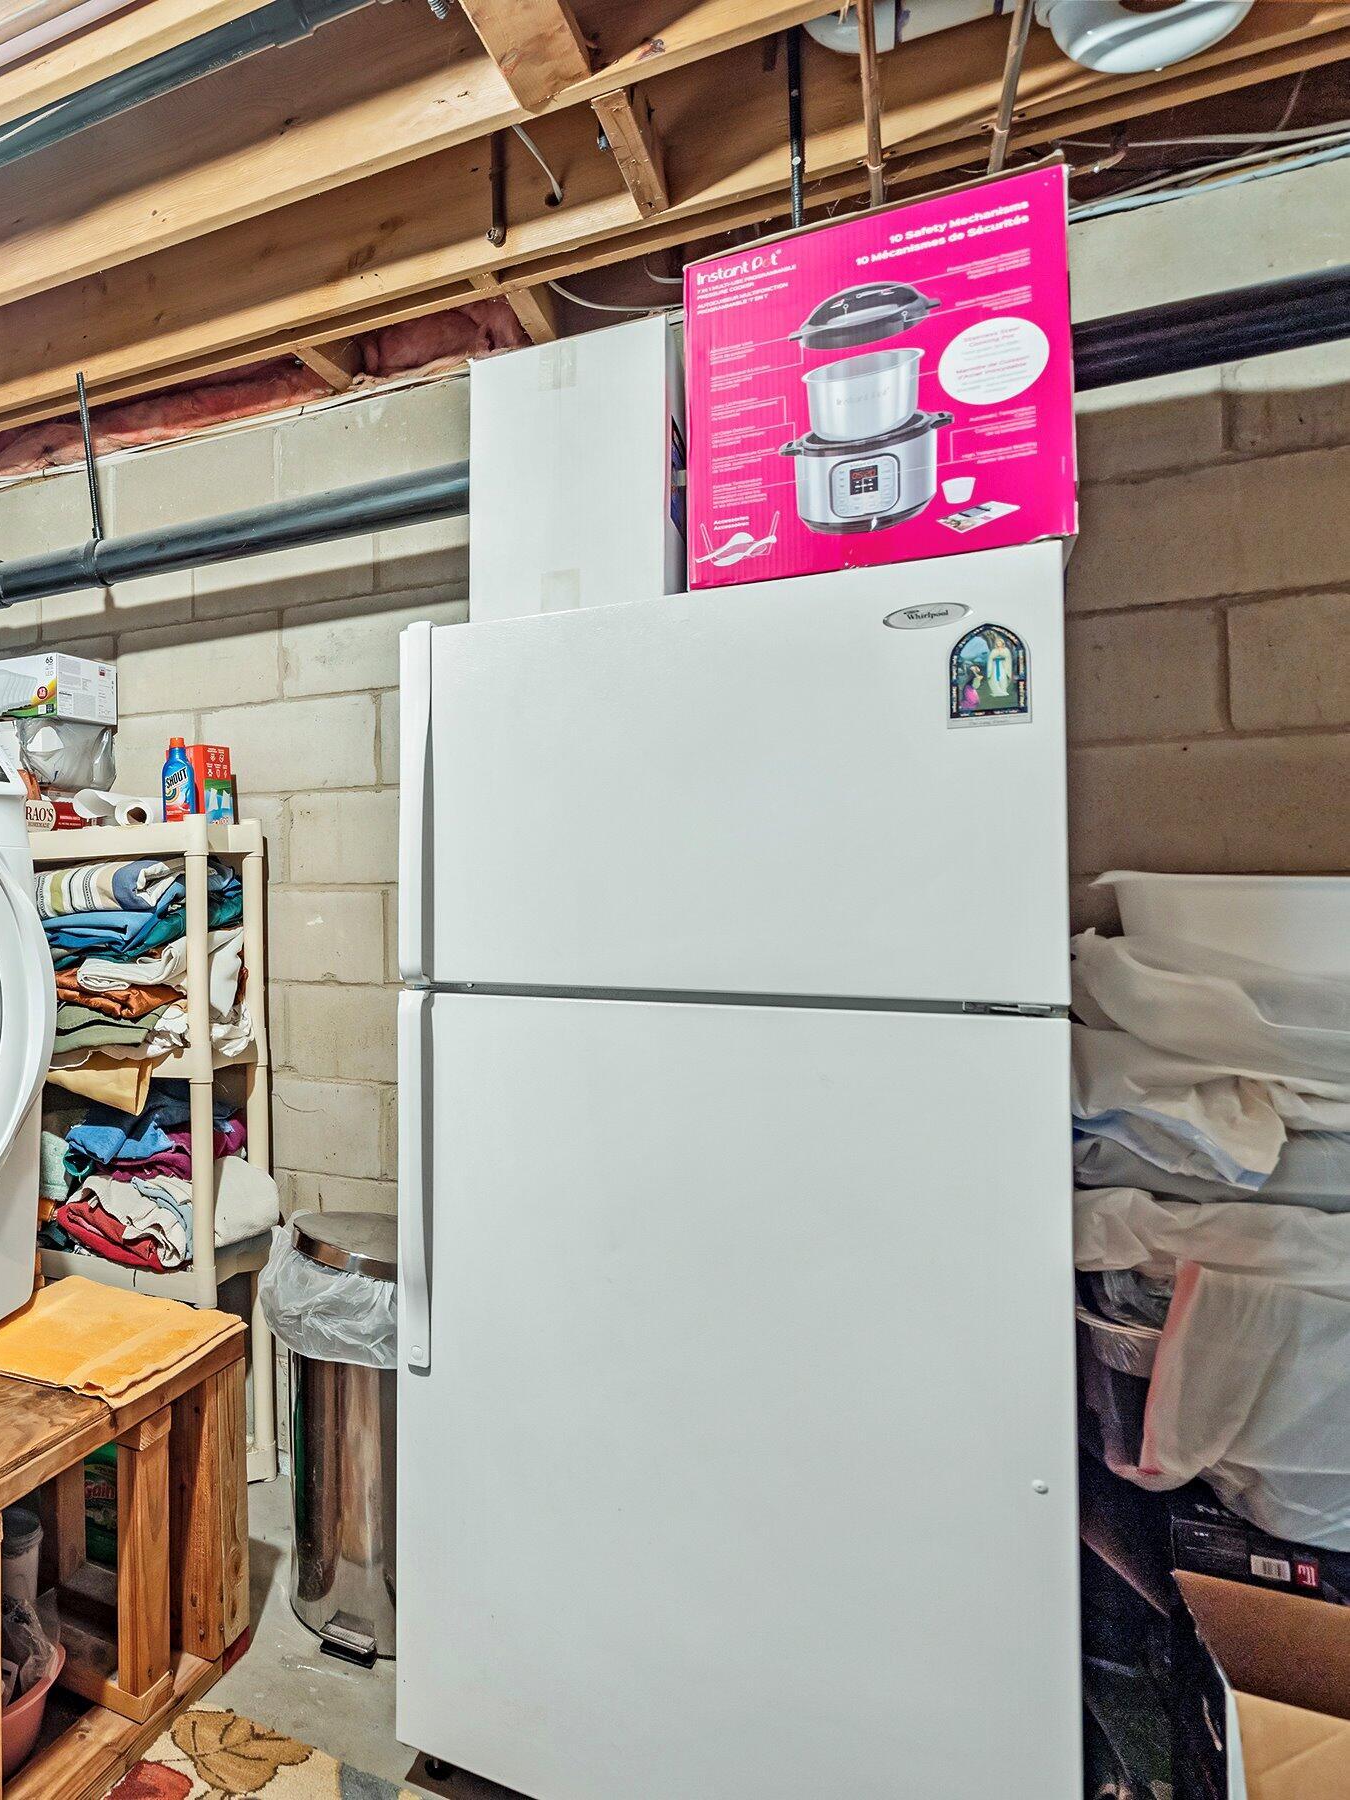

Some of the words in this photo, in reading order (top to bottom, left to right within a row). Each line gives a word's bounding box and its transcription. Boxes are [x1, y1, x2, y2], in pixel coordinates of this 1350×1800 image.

[889, 234, 903, 244] 10
[905, 222, 948, 240] Safety
[948, 200, 1030, 228] Mechanisms
[855, 256, 870, 266] 10
[871, 236, 946, 262] Mécanismes
[947, 231, 966, 243] de
[696, 260, 750, 285] Instant
[907, 610, 948, 621] Whirlpool
[45, 656, 54, 664] 65
[165, 767, 187, 789] SHOUT
[25, 806, 54, 822] RAO'S
[84, 1480, 116, 1499] Gain
